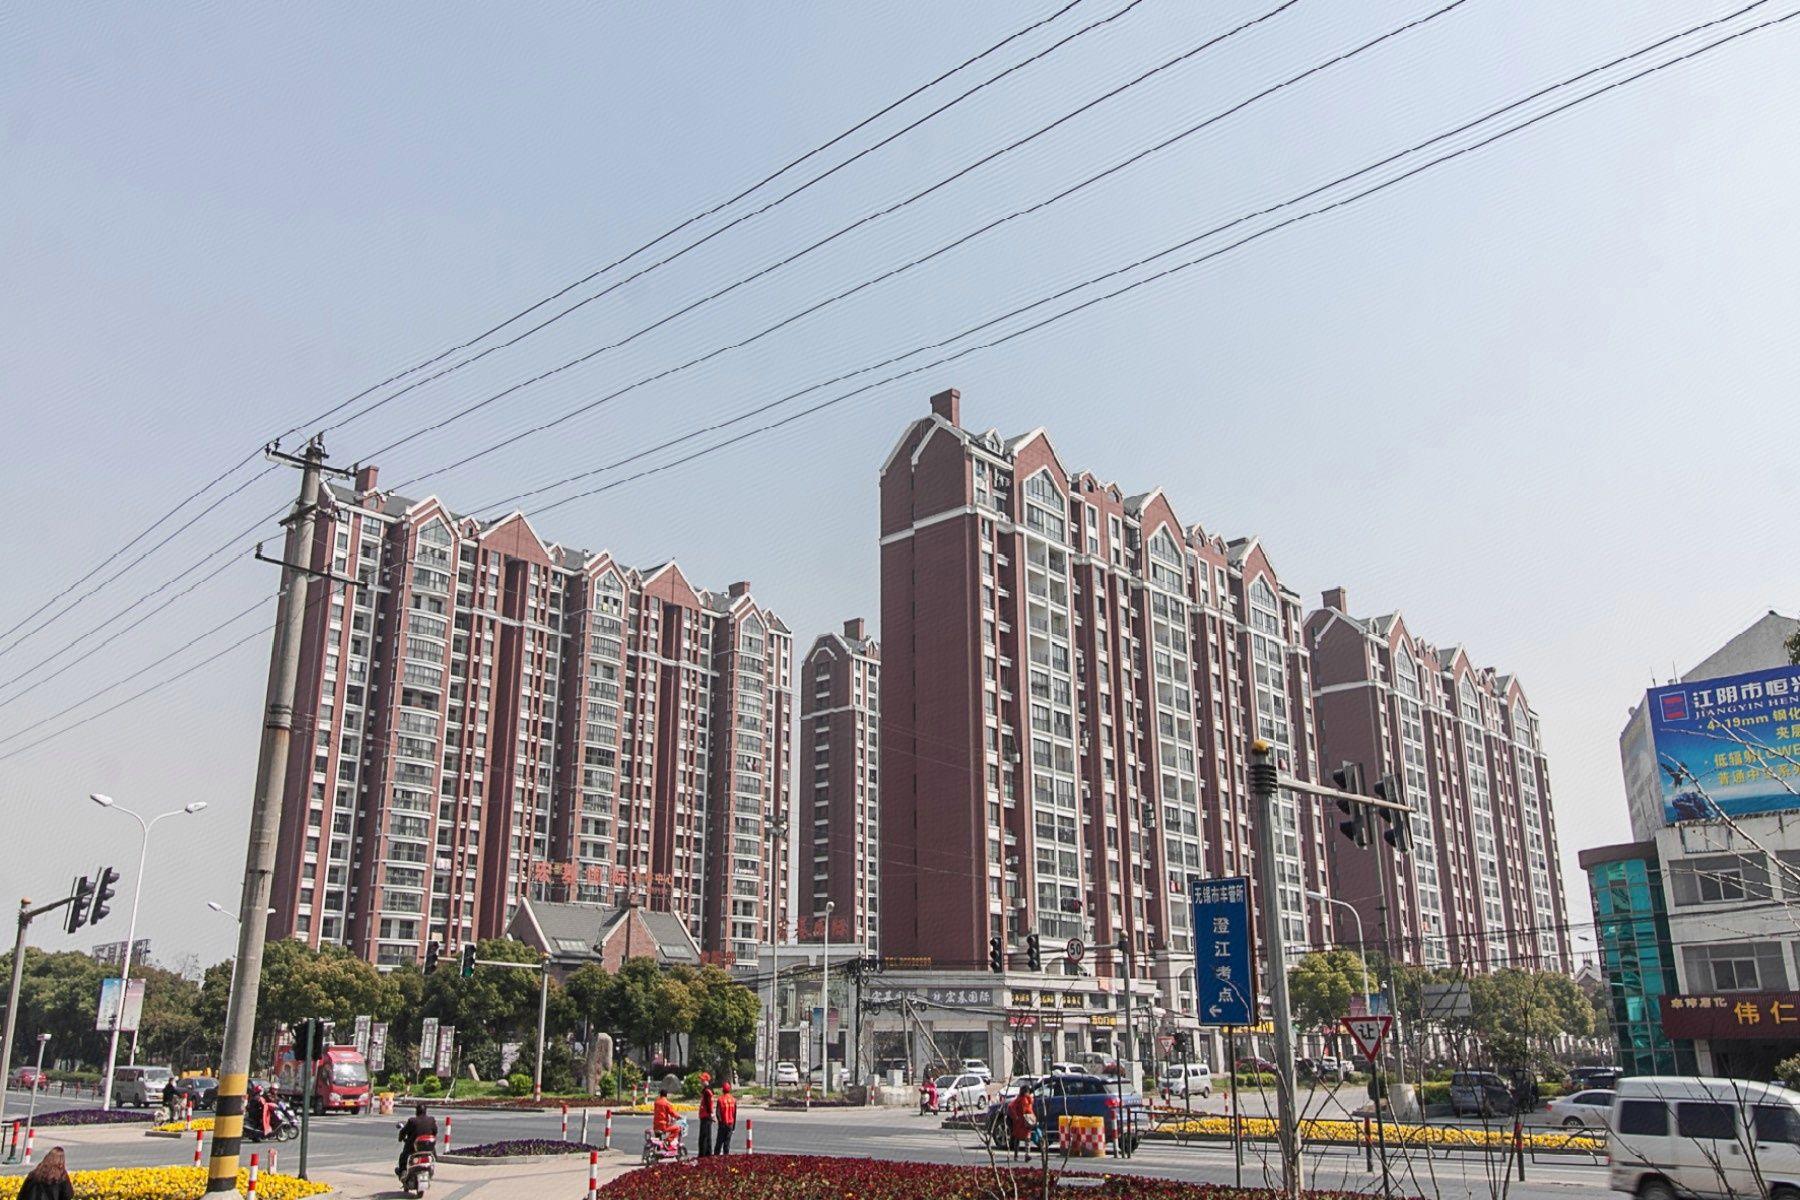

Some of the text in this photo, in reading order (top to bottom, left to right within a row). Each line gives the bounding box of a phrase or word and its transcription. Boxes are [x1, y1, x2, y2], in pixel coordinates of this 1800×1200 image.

[1695, 701, 1764, 720] JIANGYIN
[1194, 884, 1244, 905] 无锡市车管所
[1069, 942, 1082, 956] 50
[1213, 917, 1234, 1003] 澄江考点
[1733, 1000, 1799, 1025] 伟仁
[1358, 1023, 1376, 1040] 让
